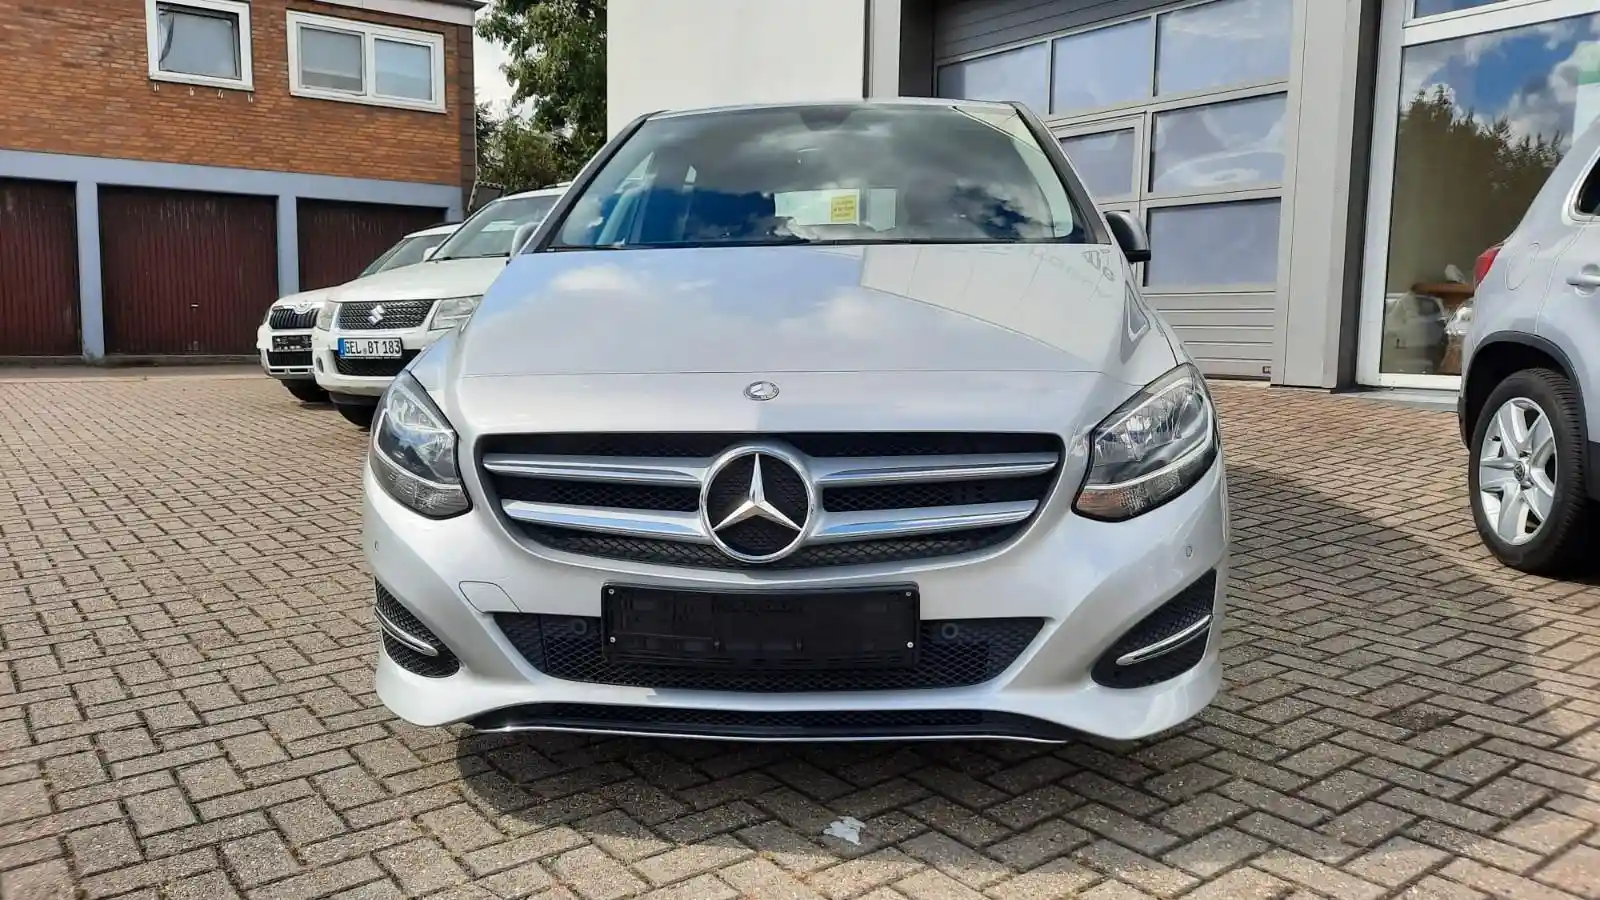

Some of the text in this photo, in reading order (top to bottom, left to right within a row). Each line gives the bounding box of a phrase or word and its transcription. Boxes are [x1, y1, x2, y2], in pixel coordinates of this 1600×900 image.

[345, 341, 400, 354] GEL BT 183
